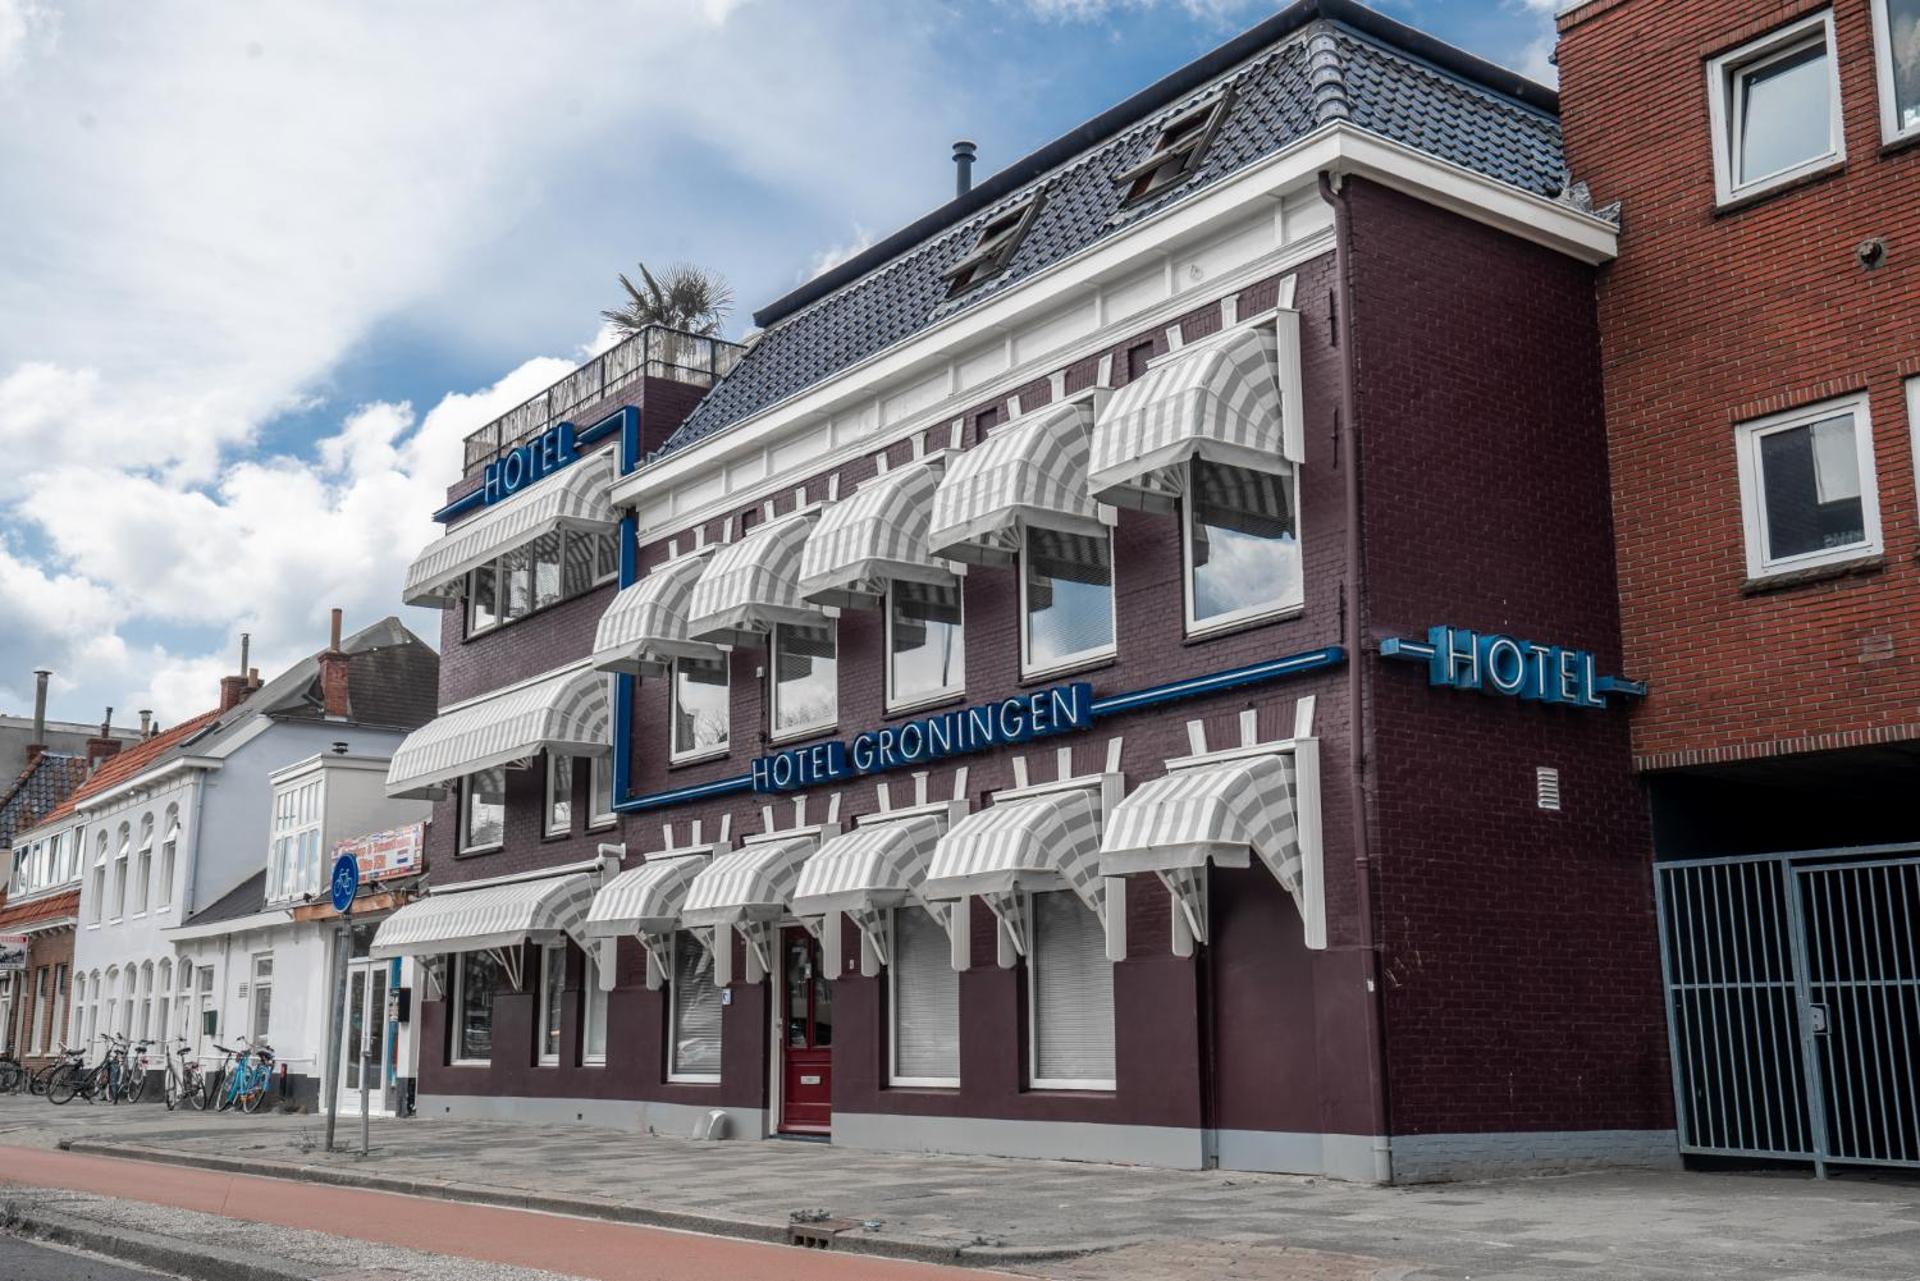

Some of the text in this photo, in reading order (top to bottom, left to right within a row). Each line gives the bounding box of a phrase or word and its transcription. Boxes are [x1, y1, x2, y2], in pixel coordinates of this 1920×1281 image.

[484, 423, 572, 504] HOTEL
[1440, 627, 1606, 707] HOTEL
[752, 683, 1086, 792] HOTEL GRONINGEN
